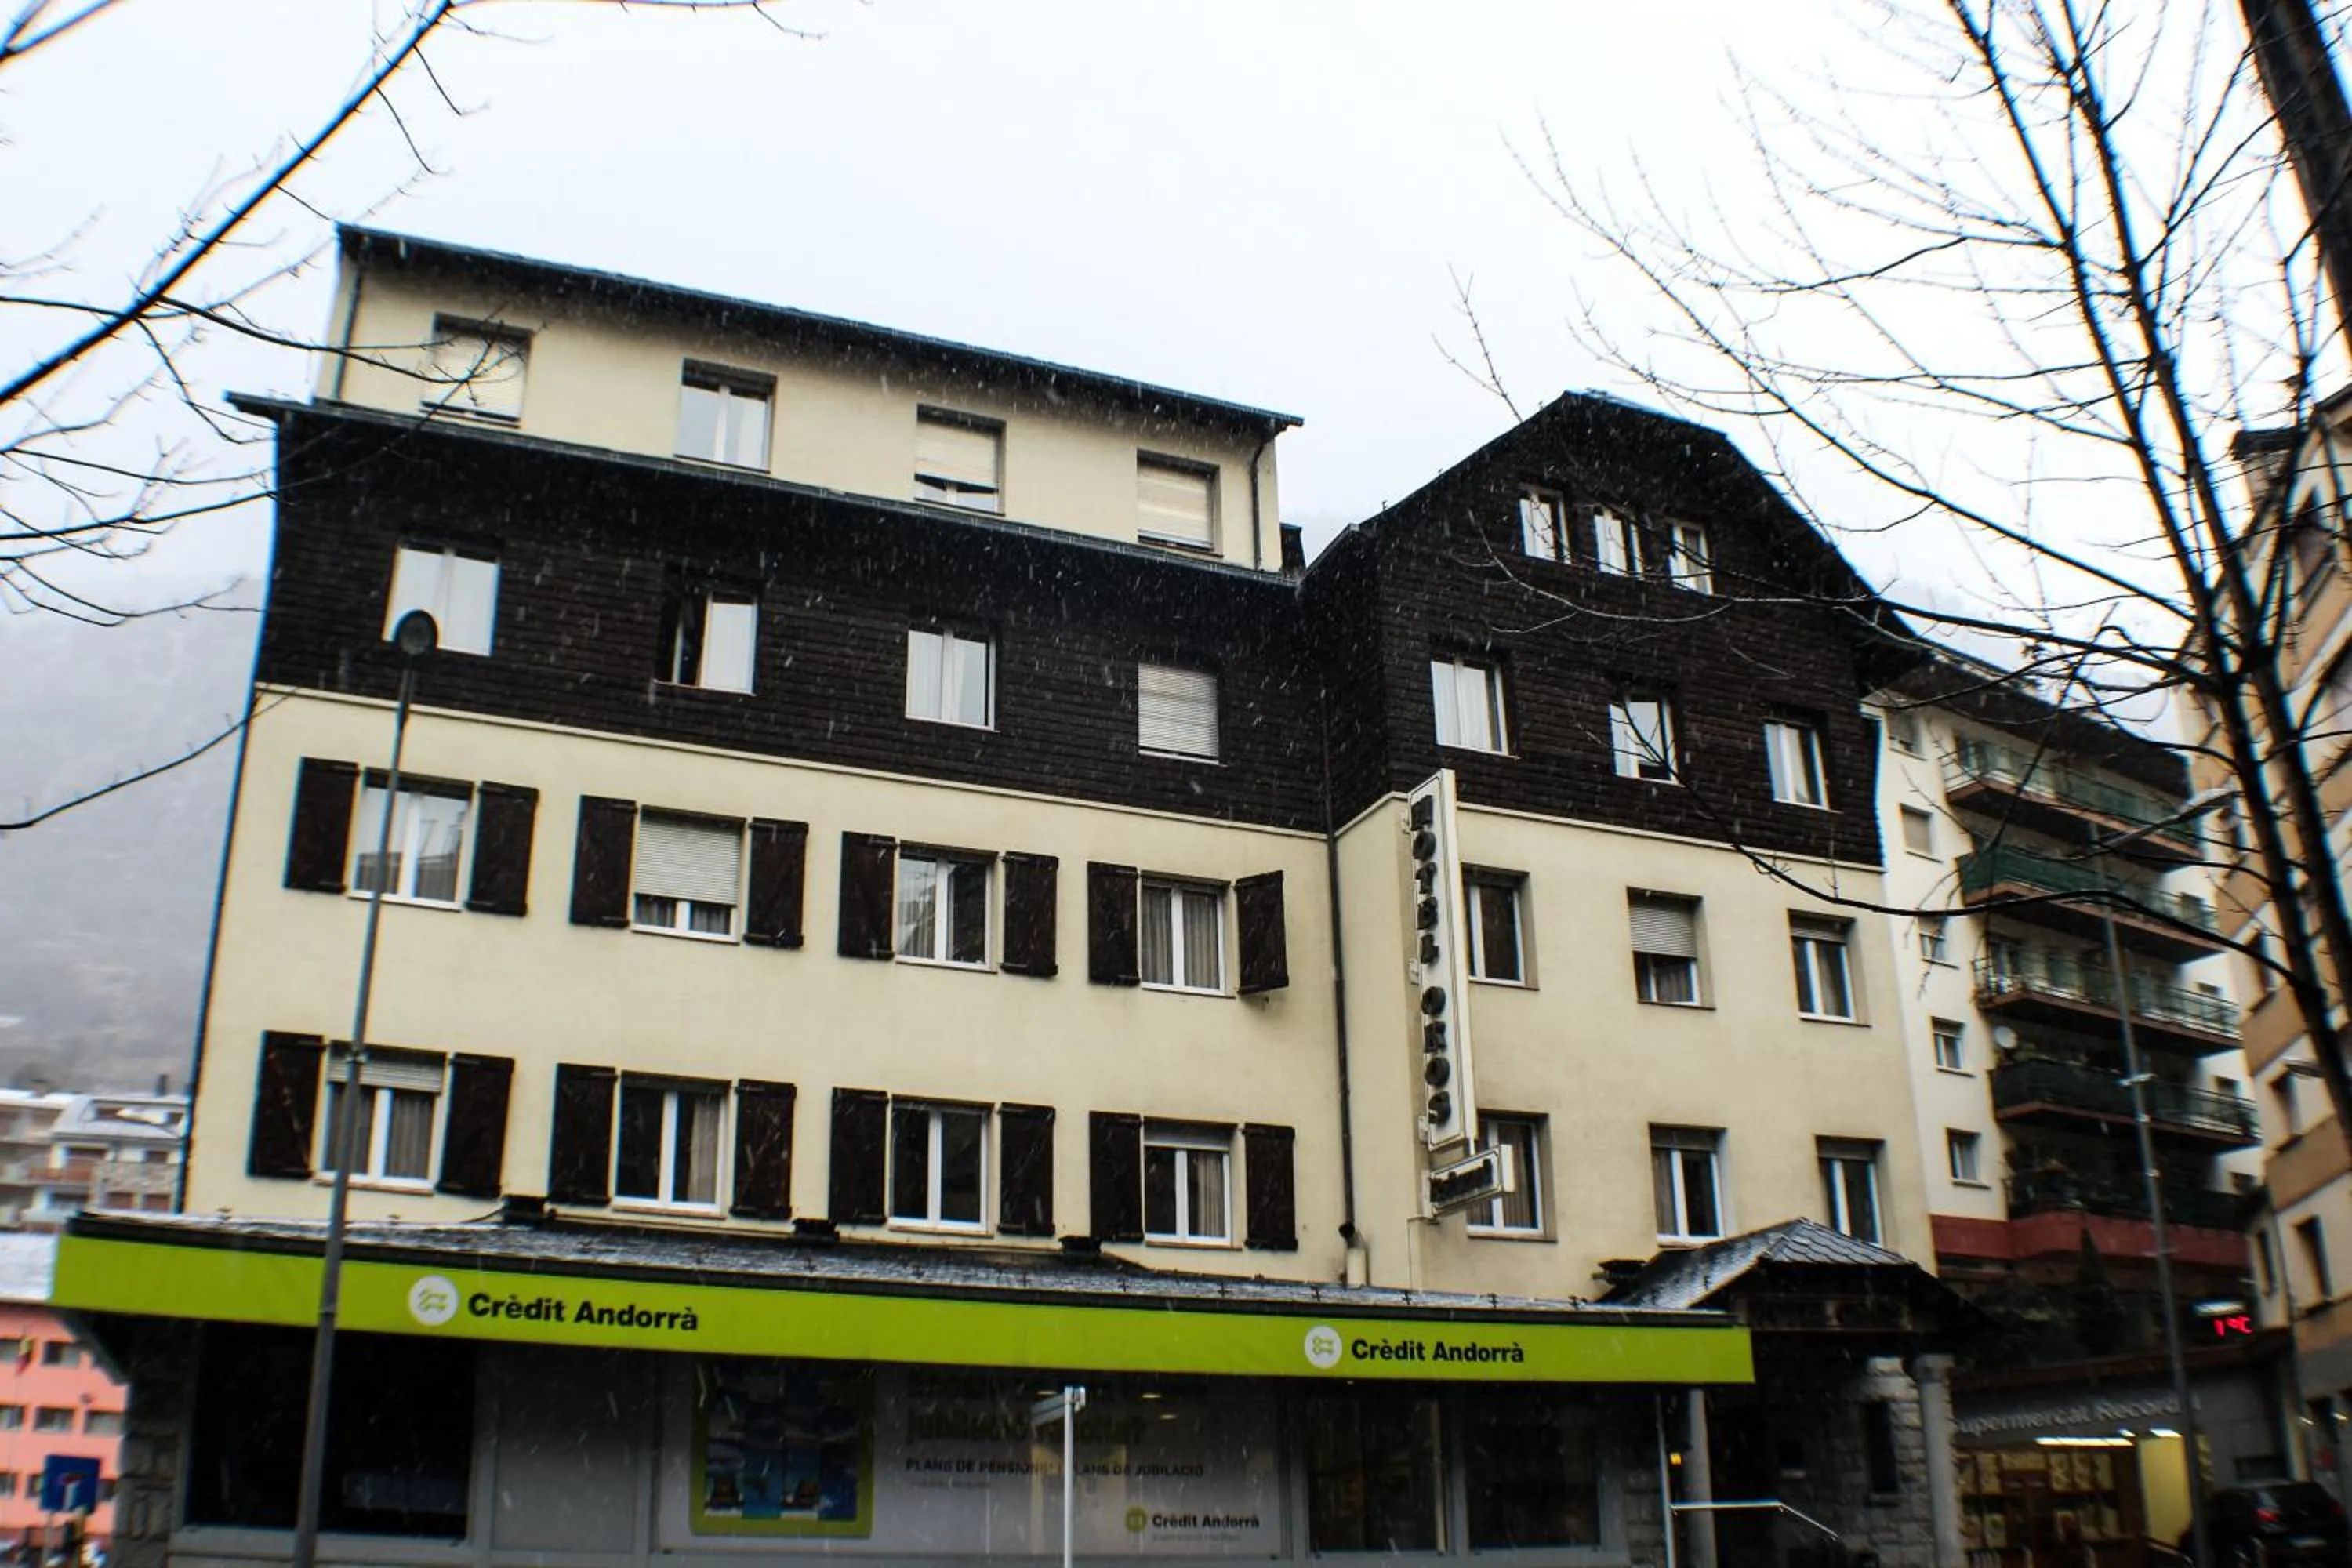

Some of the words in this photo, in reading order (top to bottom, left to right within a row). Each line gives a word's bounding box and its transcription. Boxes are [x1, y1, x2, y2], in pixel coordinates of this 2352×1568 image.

[1410, 794, 1441, 967] HOTEL
[1421, 985, 1450, 1126] OROS
[467, 1293, 565, 1322] Crèdit
[574, 1300, 698, 1331] Andorrà
[1351, 1338, 1426, 1360] Crèdit
[1432, 1341, 1524, 1363] Andorrà
[1956, 1402, 2092, 1437] upermercat
